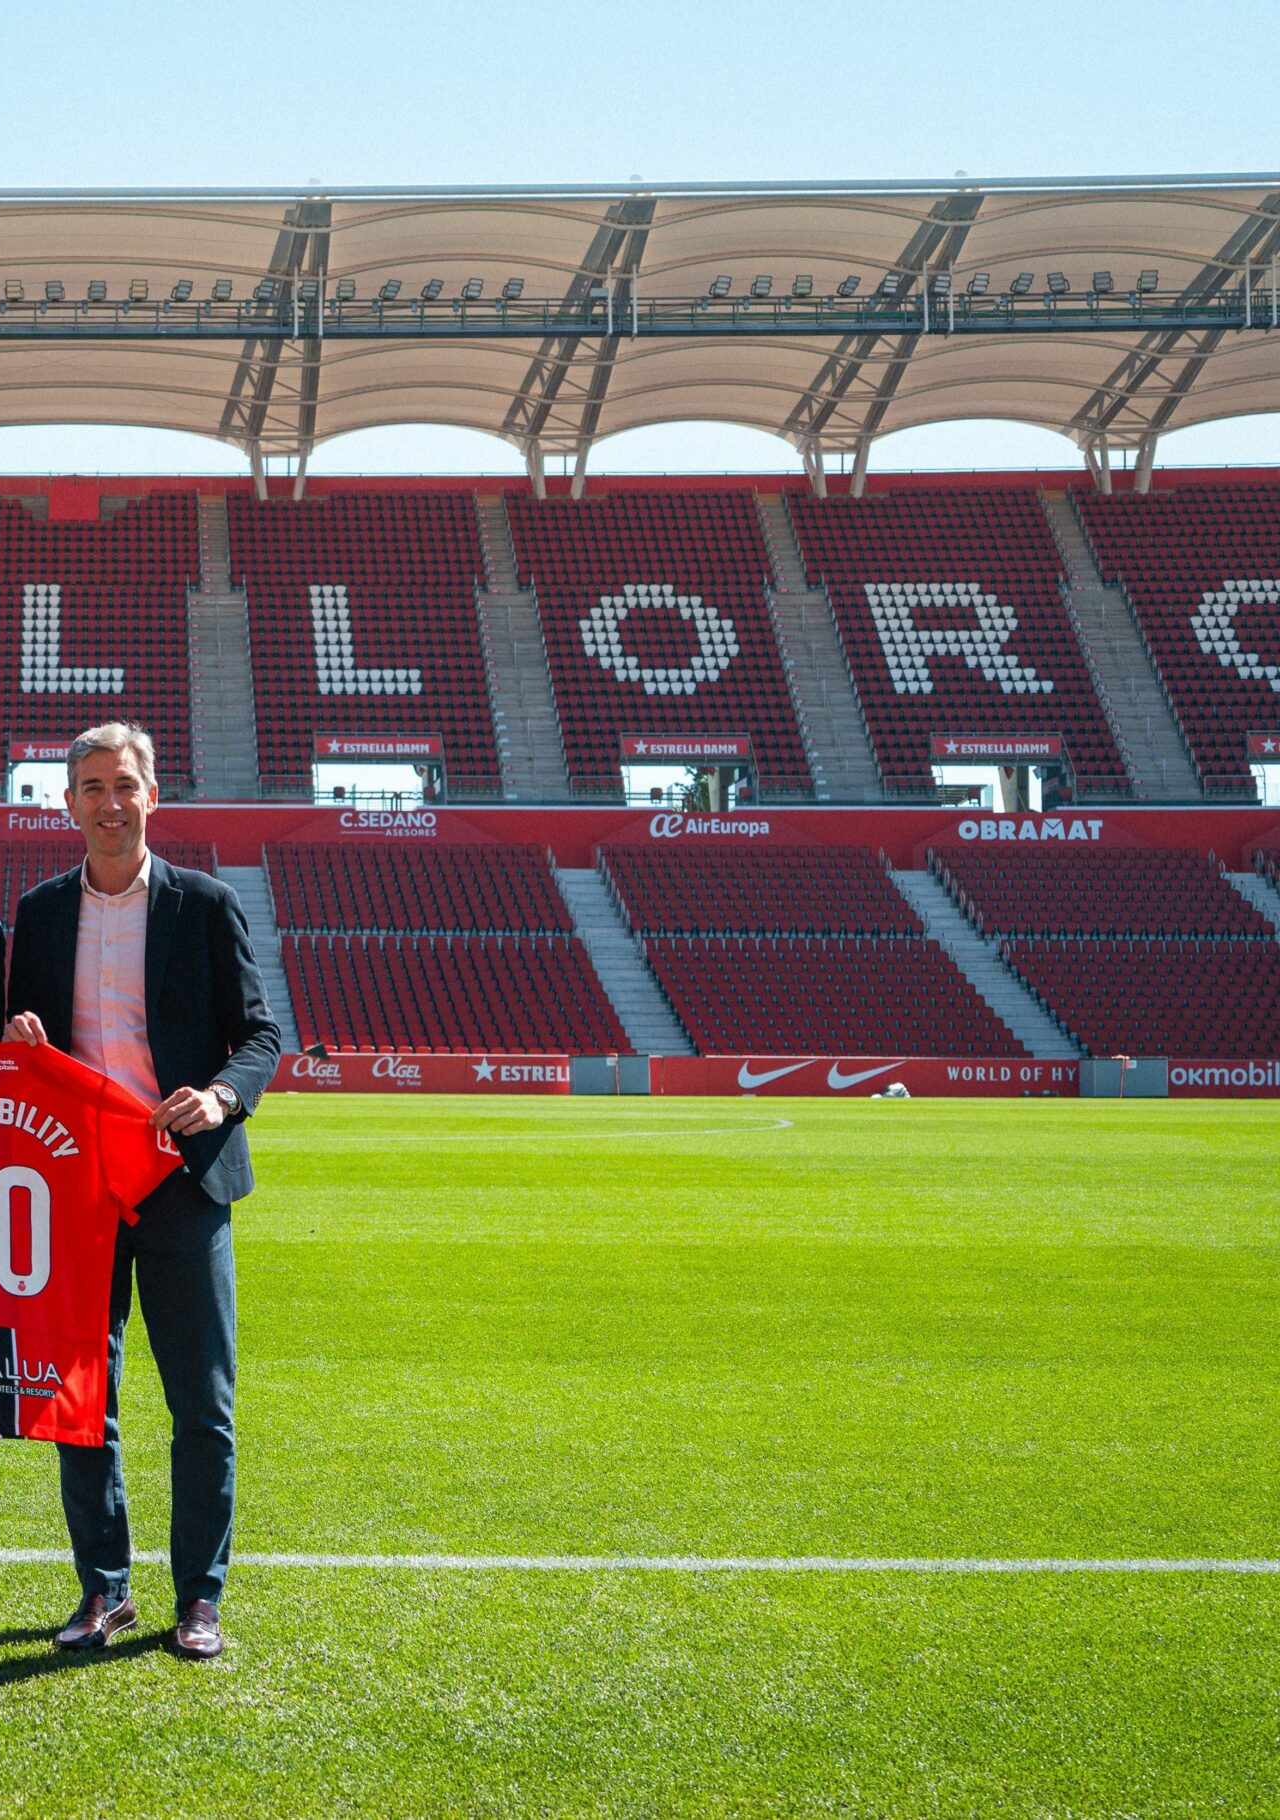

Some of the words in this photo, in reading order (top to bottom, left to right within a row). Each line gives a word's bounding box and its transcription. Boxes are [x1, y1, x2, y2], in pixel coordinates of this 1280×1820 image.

[343, 744, 394, 753] ESTRELLA
[396, 744, 429, 753] DAMM
[650, 744, 701, 754] ESTRELLA
[704, 744, 737, 754] DAMM
[961, 744, 1012, 754] ESTRELLA
[1015, 744, 1049, 754] DAMM
[340, 812, 437, 827] C.SEDANO
[385, 828, 437, 837] ASESORES
[957, 818, 1103, 841] OBRAMAT
[947, 1066, 1011, 1081] WORLD
[1020, 1067, 1043, 1081] OF
[26, 1387, 55, 1399] RESORTS
